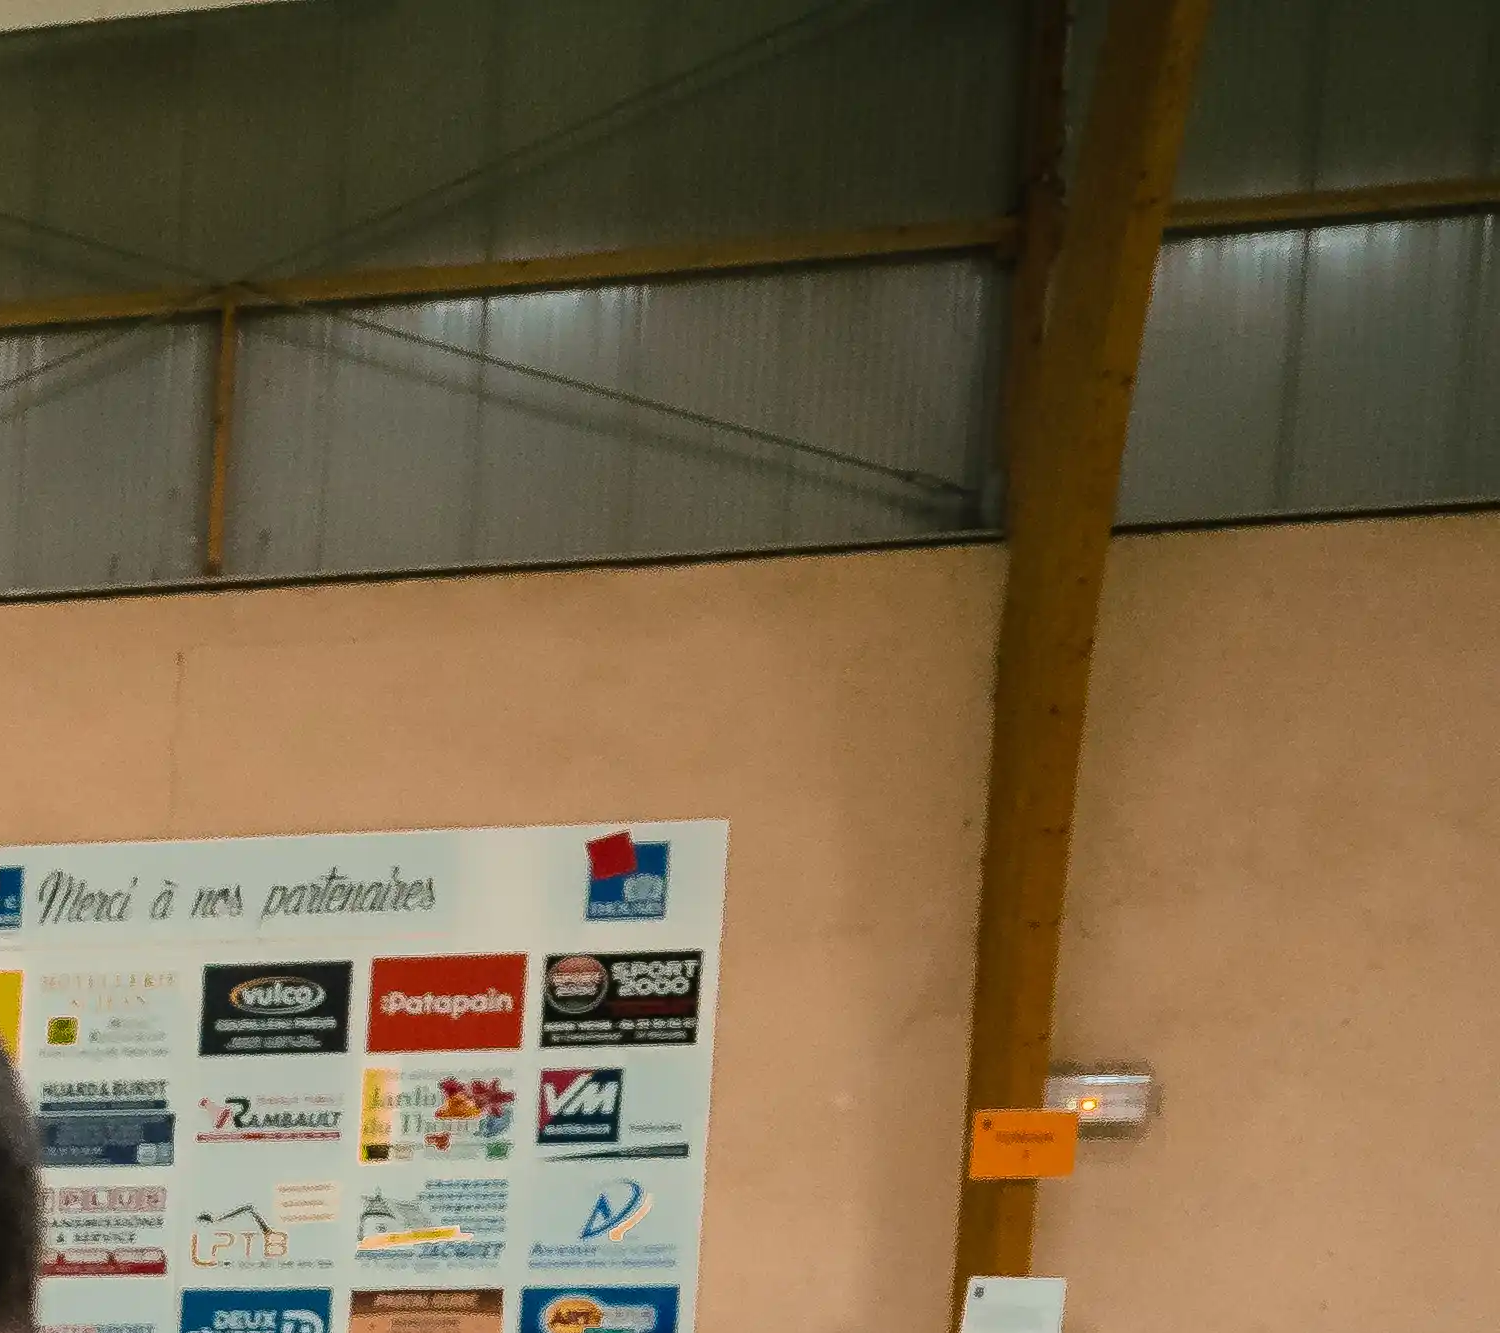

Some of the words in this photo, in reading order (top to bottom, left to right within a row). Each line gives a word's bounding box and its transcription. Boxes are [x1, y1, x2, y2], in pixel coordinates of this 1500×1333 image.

[37, 868, 139, 927] Merci
[148, 879, 180, 920] à
[188, 882, 245, 920] nos
[257, 865, 437, 930] partenaires
[611, 959, 699, 981] SPORT
[240, 981, 315, 1009] vulco
[616, 976, 691, 997] 2000
[386, 986, 515, 1020] Patapain
[545, 1072, 619, 1116] VM
[225, 1096, 345, 1129] RAMBAULT
[213, 1308, 278, 1330] DEUX
